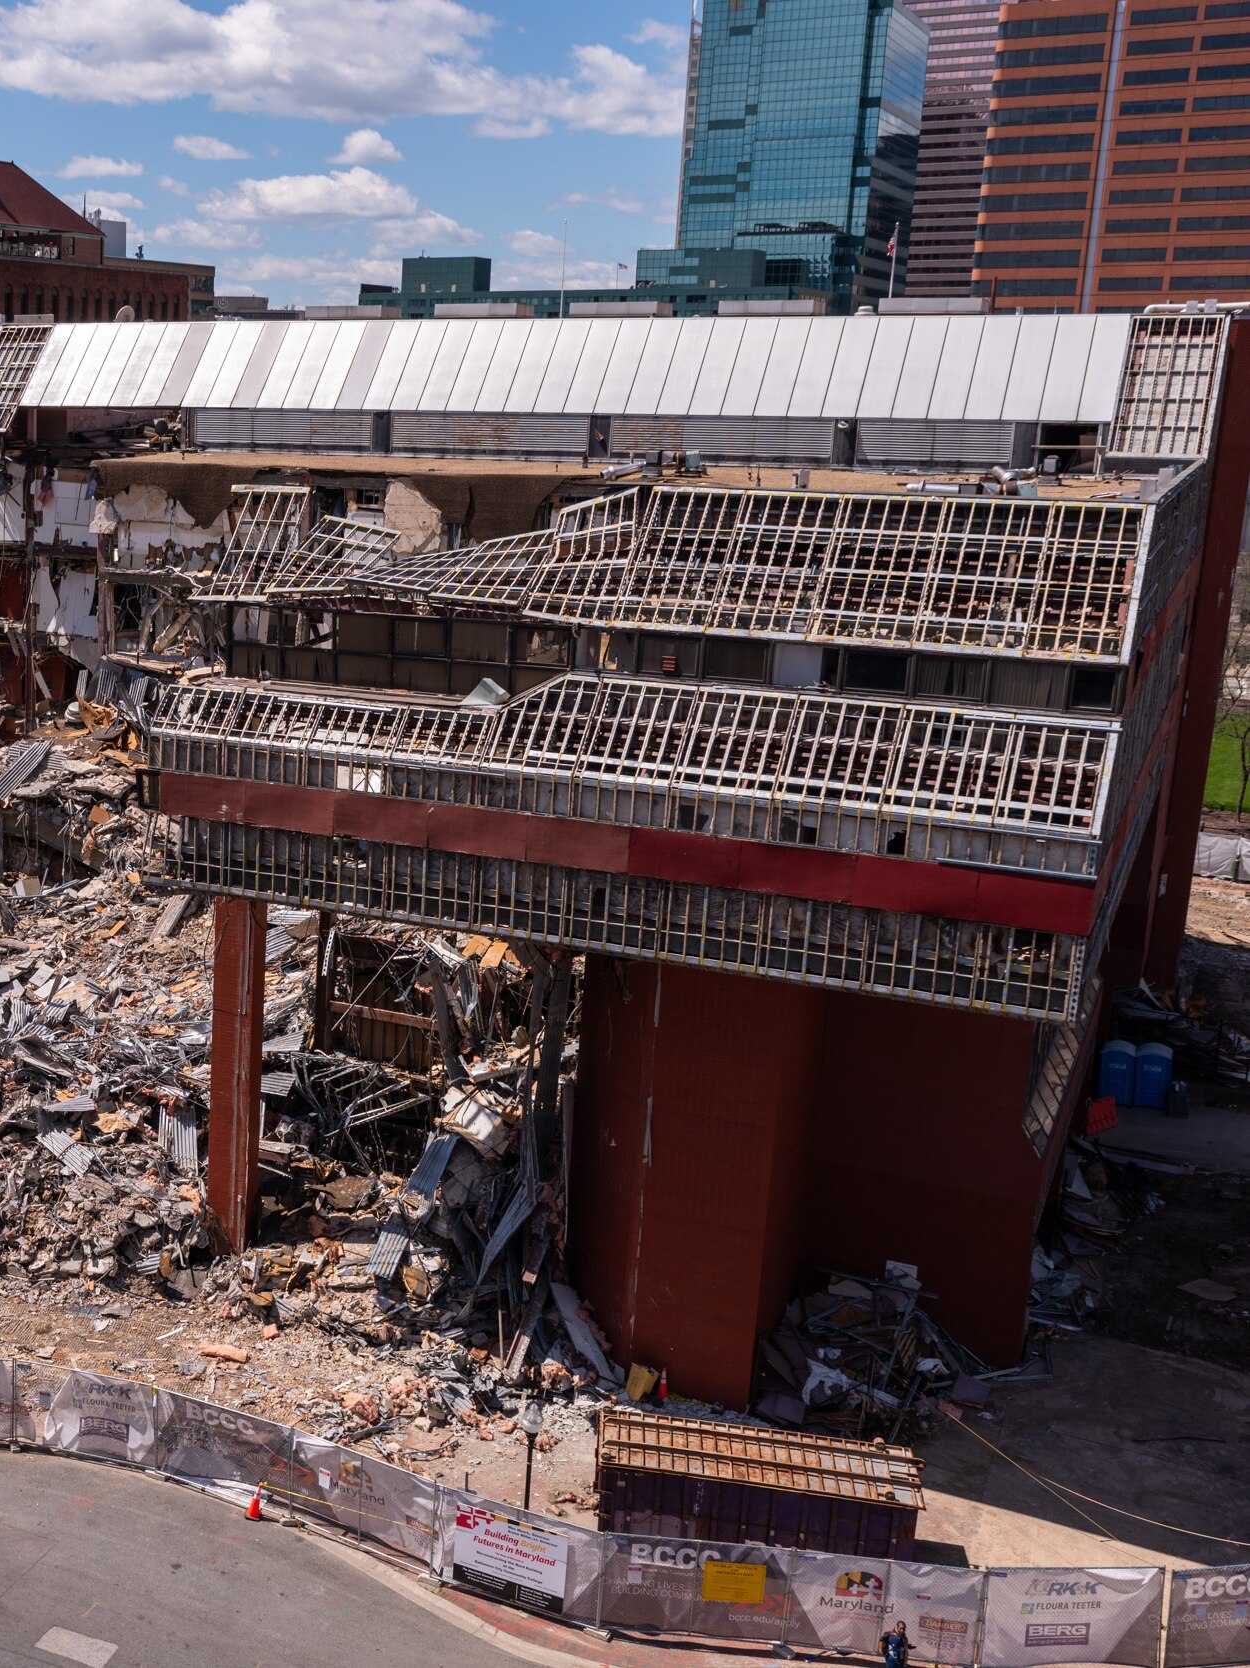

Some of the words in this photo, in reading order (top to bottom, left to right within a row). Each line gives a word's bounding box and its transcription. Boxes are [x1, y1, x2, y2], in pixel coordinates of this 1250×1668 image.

[111, 1401, 137, 1413] TEETER
[185, 1400, 255, 1435] BCCC
[81, 1418, 128, 1435] BERG
[484, 1528, 519, 1546] Building
[520, 1540, 547, 1554] Bright
[473, 1535, 505, 1551] Futures
[505, 1545, 514, 1554] in
[515, 1548, 556, 1567] Maryland
[630, 1543, 722, 1570] BCCC
[494, 1565, 503, 1573] City
[611, 1585, 658, 1598] BUILDING
[657, 1580, 686, 1592] LIVES
[1184, 1574, 1250, 1599] BCC
[819, 1596, 895, 1614] Maryland
[1035, 1601, 1069, 1610] FLOURA
[1072, 1600, 1102, 1609] TEETER
[1207, 1610, 1234, 1620] LIVES
[926, 1619, 962, 1632] DANGER
[1028, 1625, 1087, 1637] BERG
